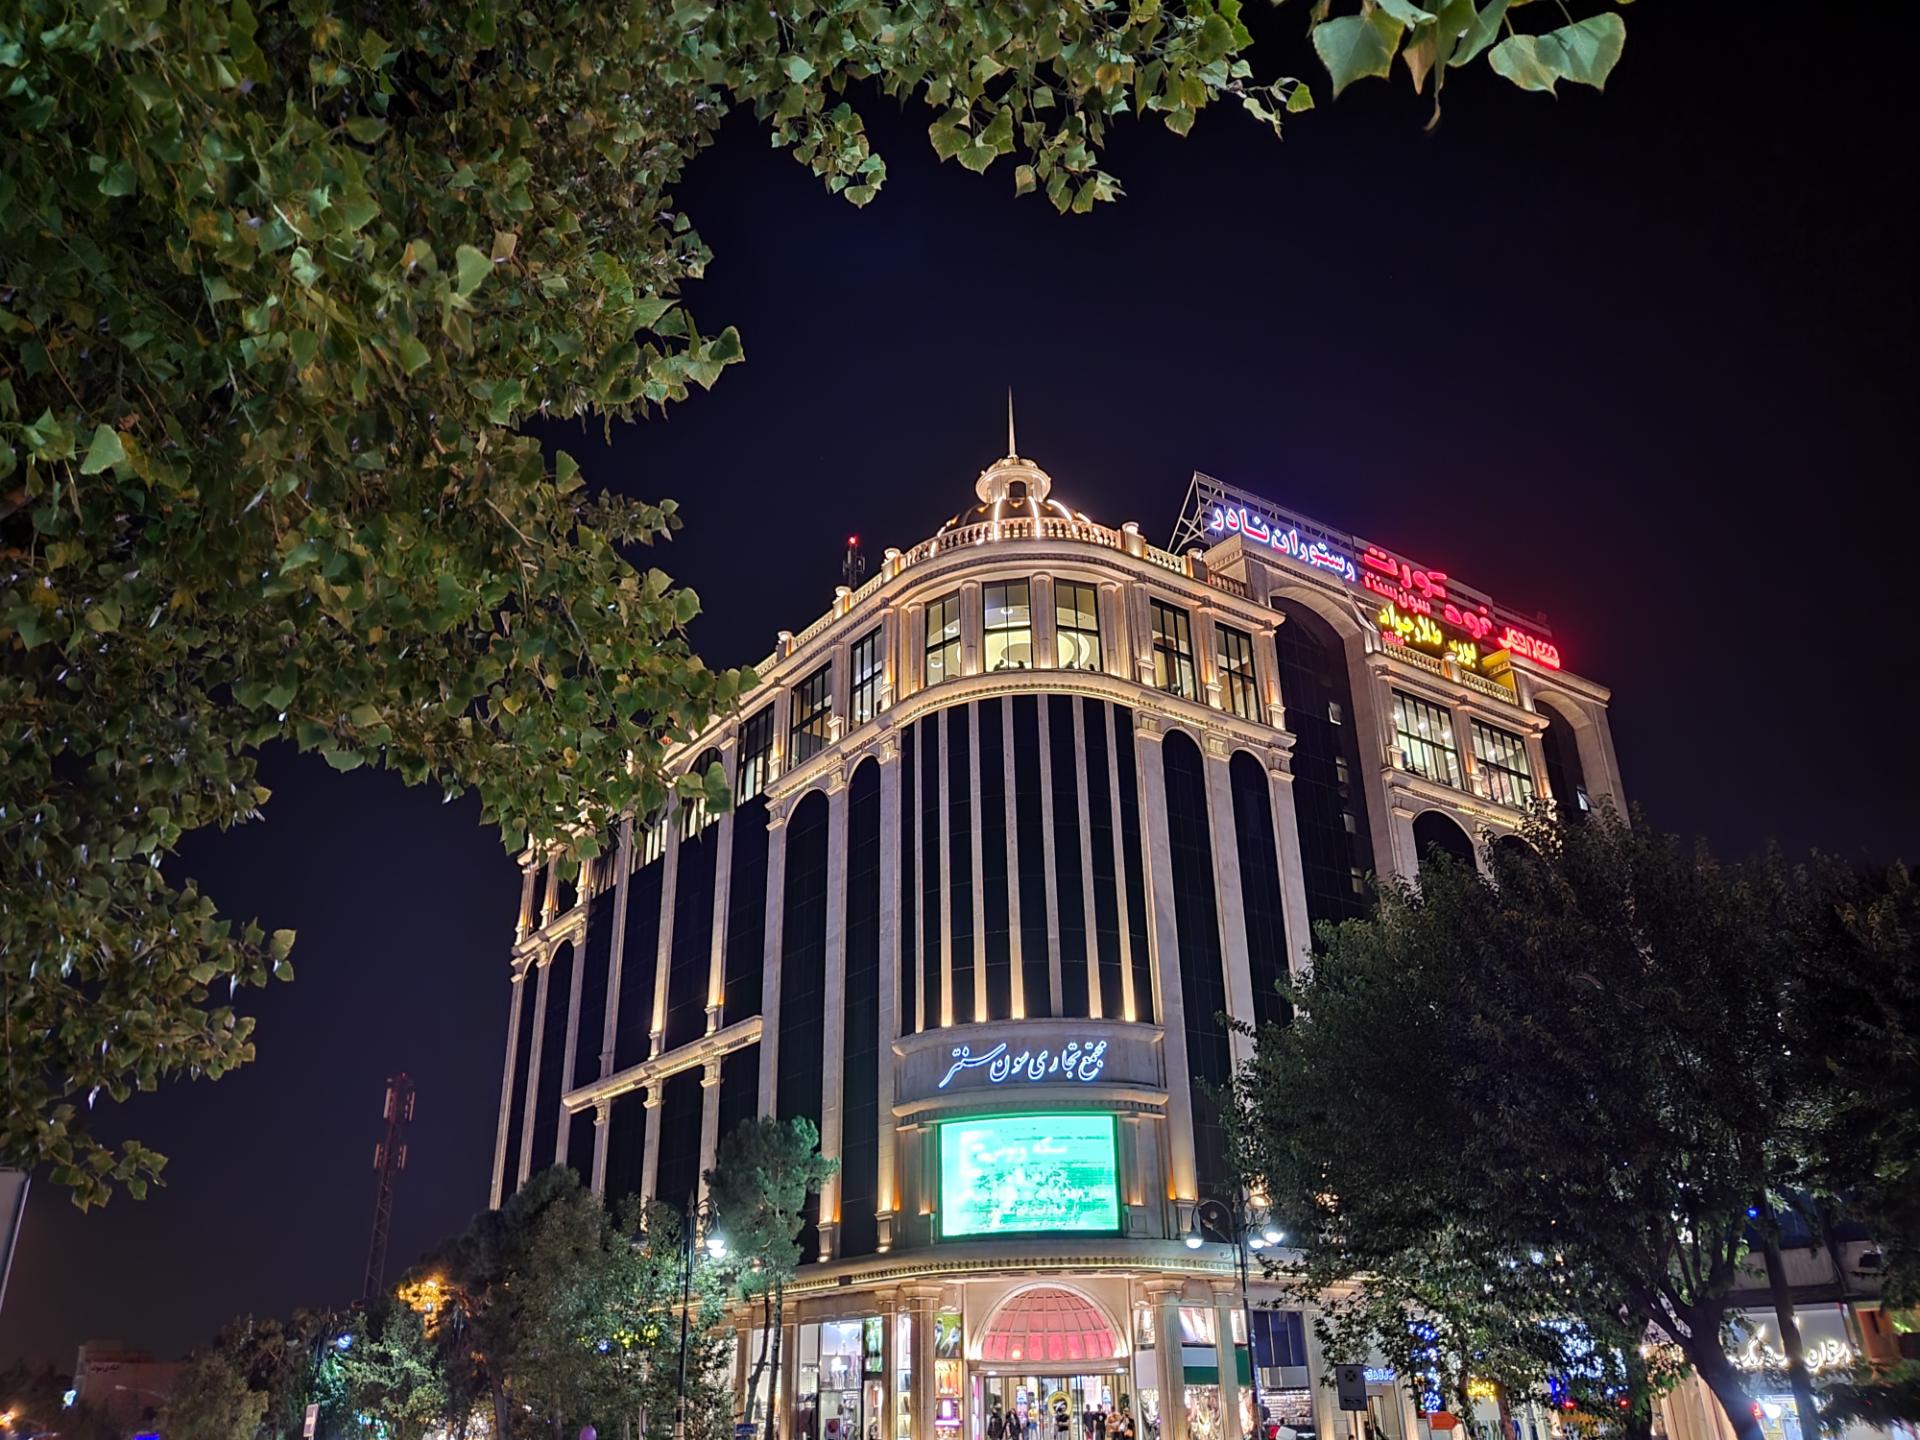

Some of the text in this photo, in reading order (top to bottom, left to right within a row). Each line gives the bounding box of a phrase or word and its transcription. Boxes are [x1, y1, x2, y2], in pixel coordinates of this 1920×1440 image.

[1211, 507, 1355, 581] رستوران نادر
[1364, 548, 1492, 638] فود کورت
[938, 1040, 1107, 1088] مجتمع تجاری سون سنتر
